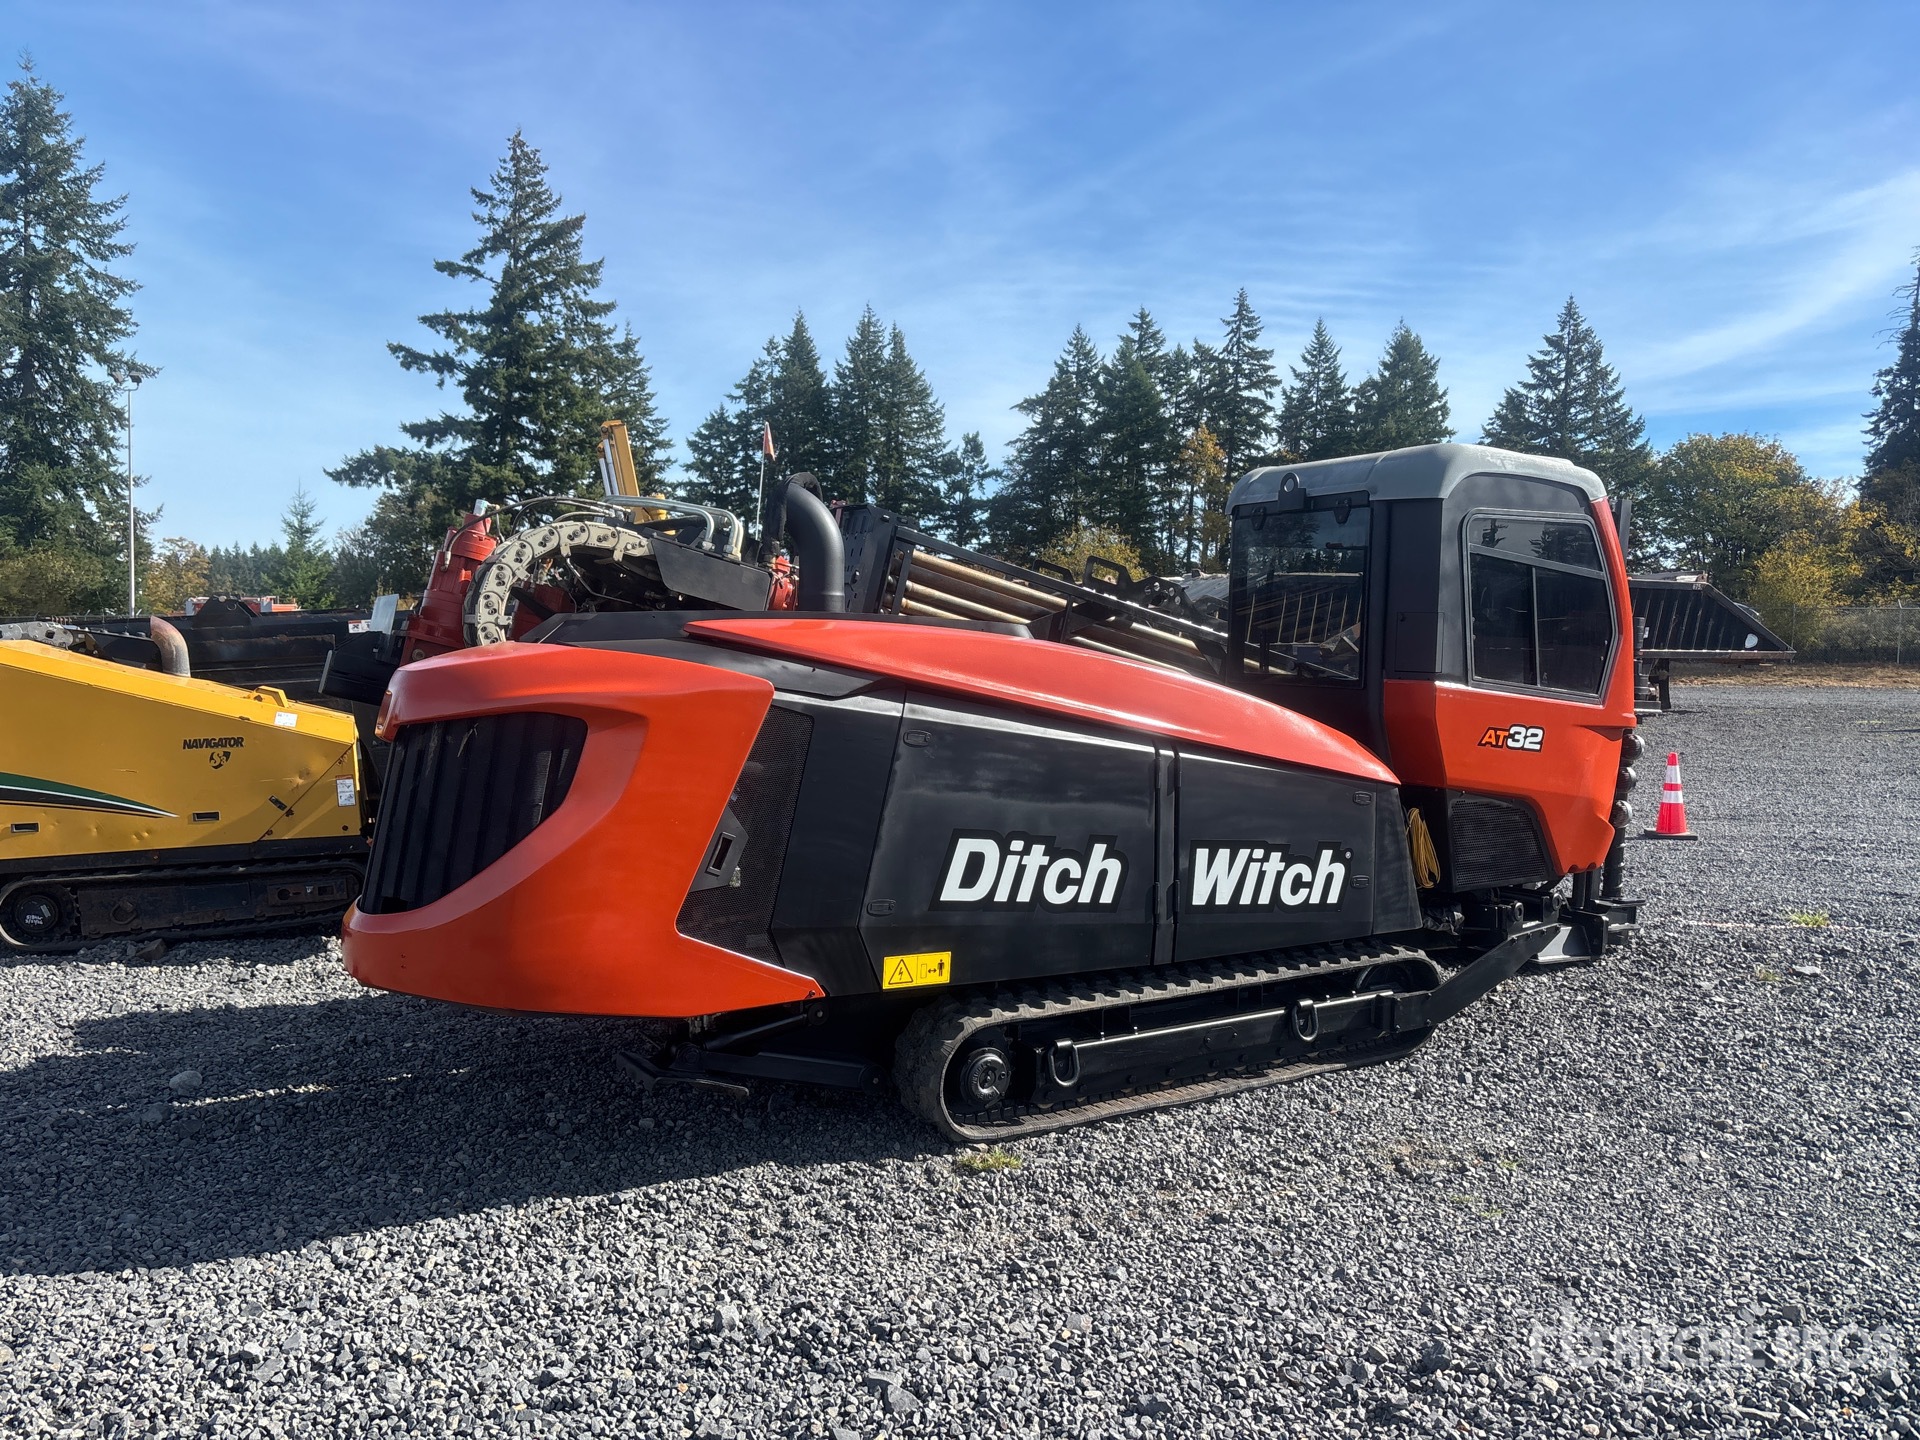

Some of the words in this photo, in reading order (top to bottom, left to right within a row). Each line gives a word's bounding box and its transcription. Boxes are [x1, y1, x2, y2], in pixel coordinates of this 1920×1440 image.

[183, 736, 244, 749] NAVIGATOR
[1481, 726, 1544, 750] AT32
[939, 838, 1122, 904] Ditch
[1191, 847, 1346, 906] Witch
